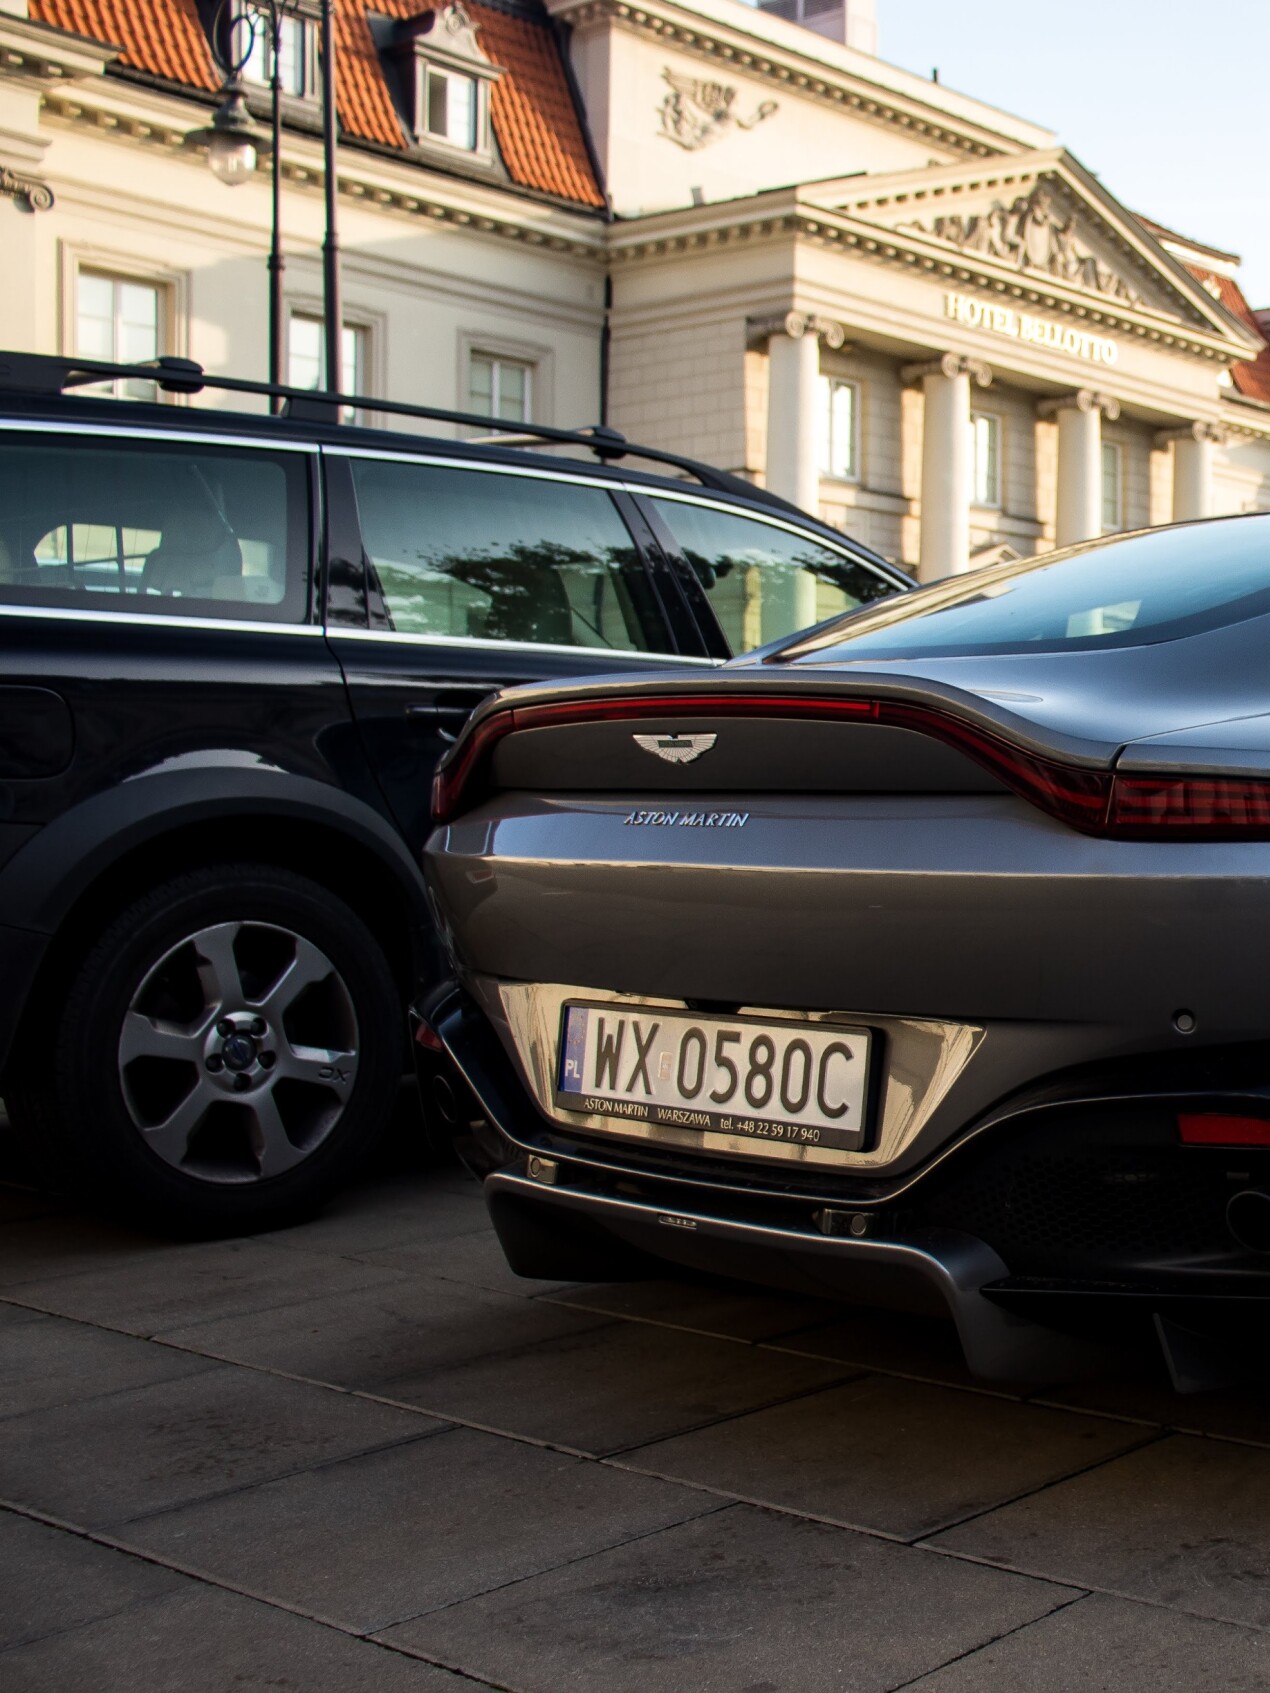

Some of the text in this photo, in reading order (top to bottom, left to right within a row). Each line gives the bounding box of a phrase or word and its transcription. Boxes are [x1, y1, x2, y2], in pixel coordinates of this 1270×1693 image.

[944, 293, 1119, 366] HOTEL BELLOTTO
[624, 811, 750, 827] ASTON MARTIN
[565, 1058, 580, 1079] PL
[595, 1016, 660, 1096] WX
[584, 1098, 821, 1142] ASTON MARTIN WARSZAWA tel. +48 22 59 17 940
